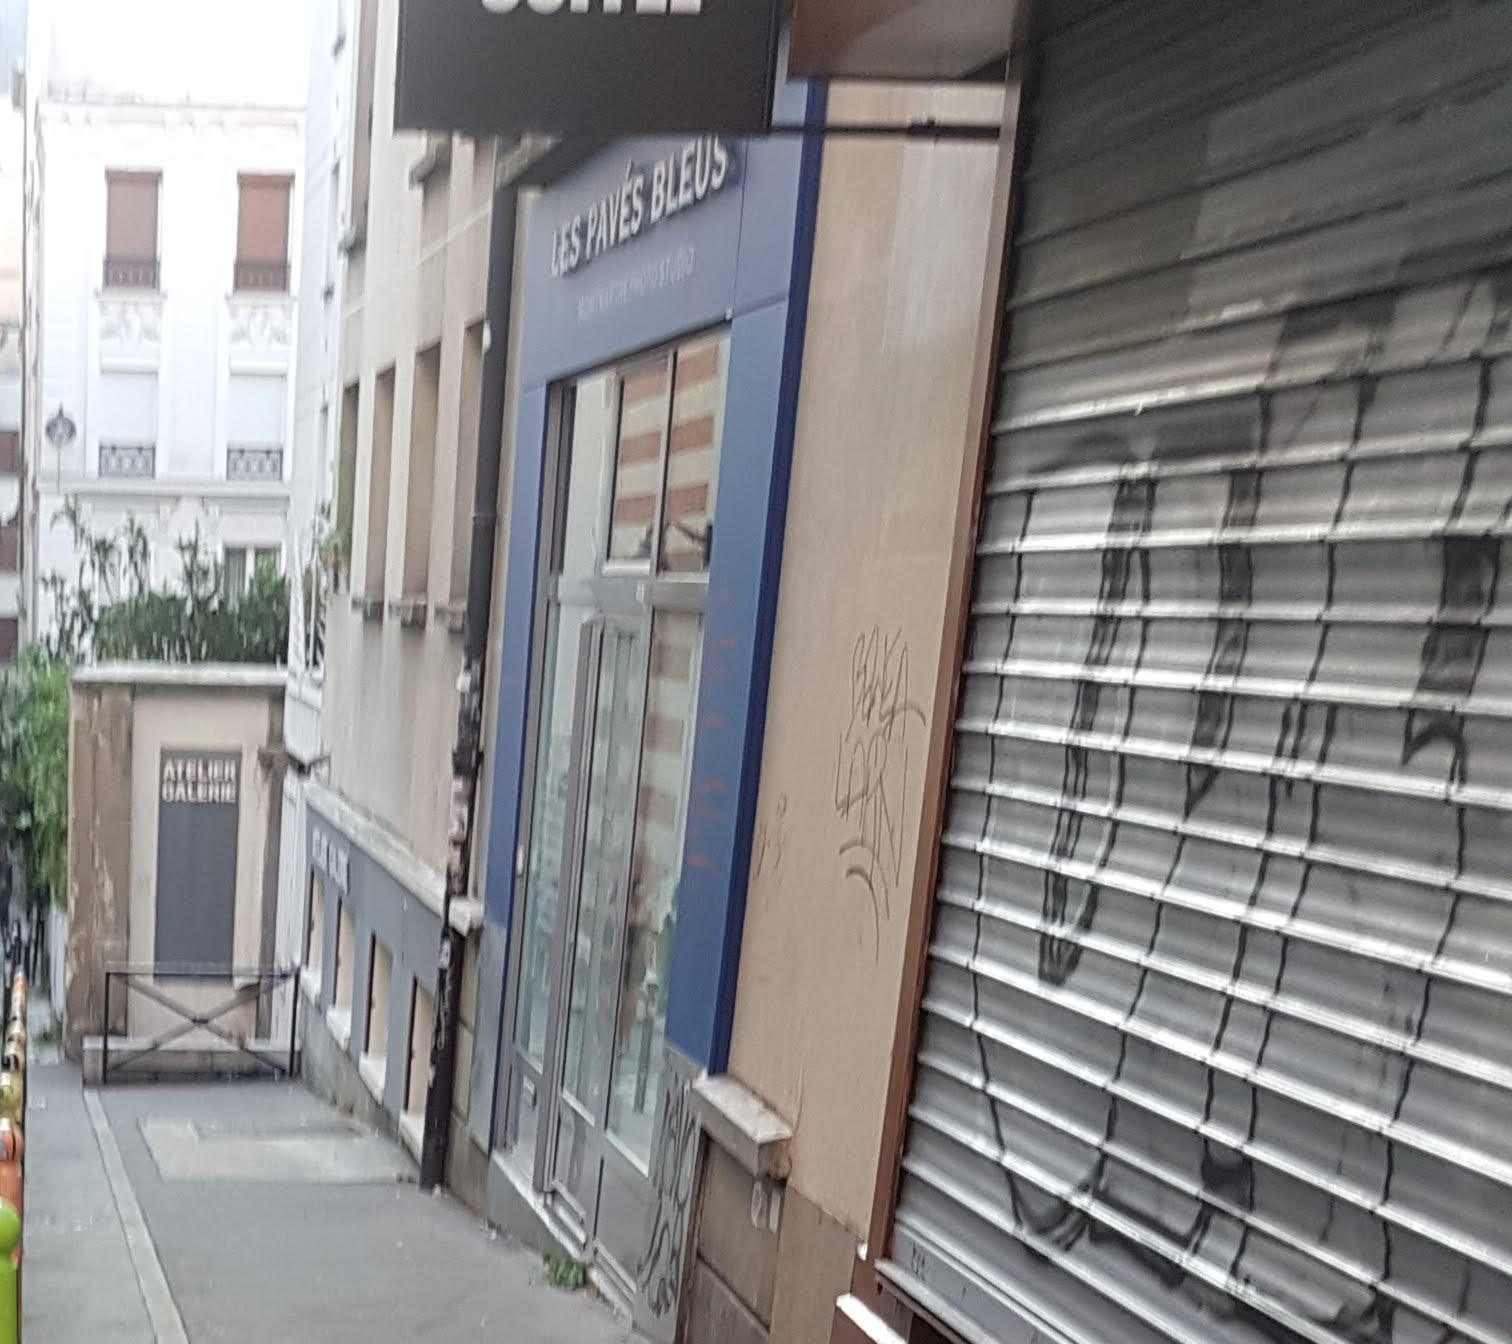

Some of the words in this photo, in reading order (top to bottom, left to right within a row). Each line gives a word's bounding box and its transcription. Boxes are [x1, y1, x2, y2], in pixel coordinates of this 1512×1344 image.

[551, 214, 581, 277] LES
[585, 155, 644, 261] PAVÉS
[650, 133, 729, 224] BLEUS
[163, 757, 236, 781] ATELIER
[162, 781, 236, 803] GALERIE
